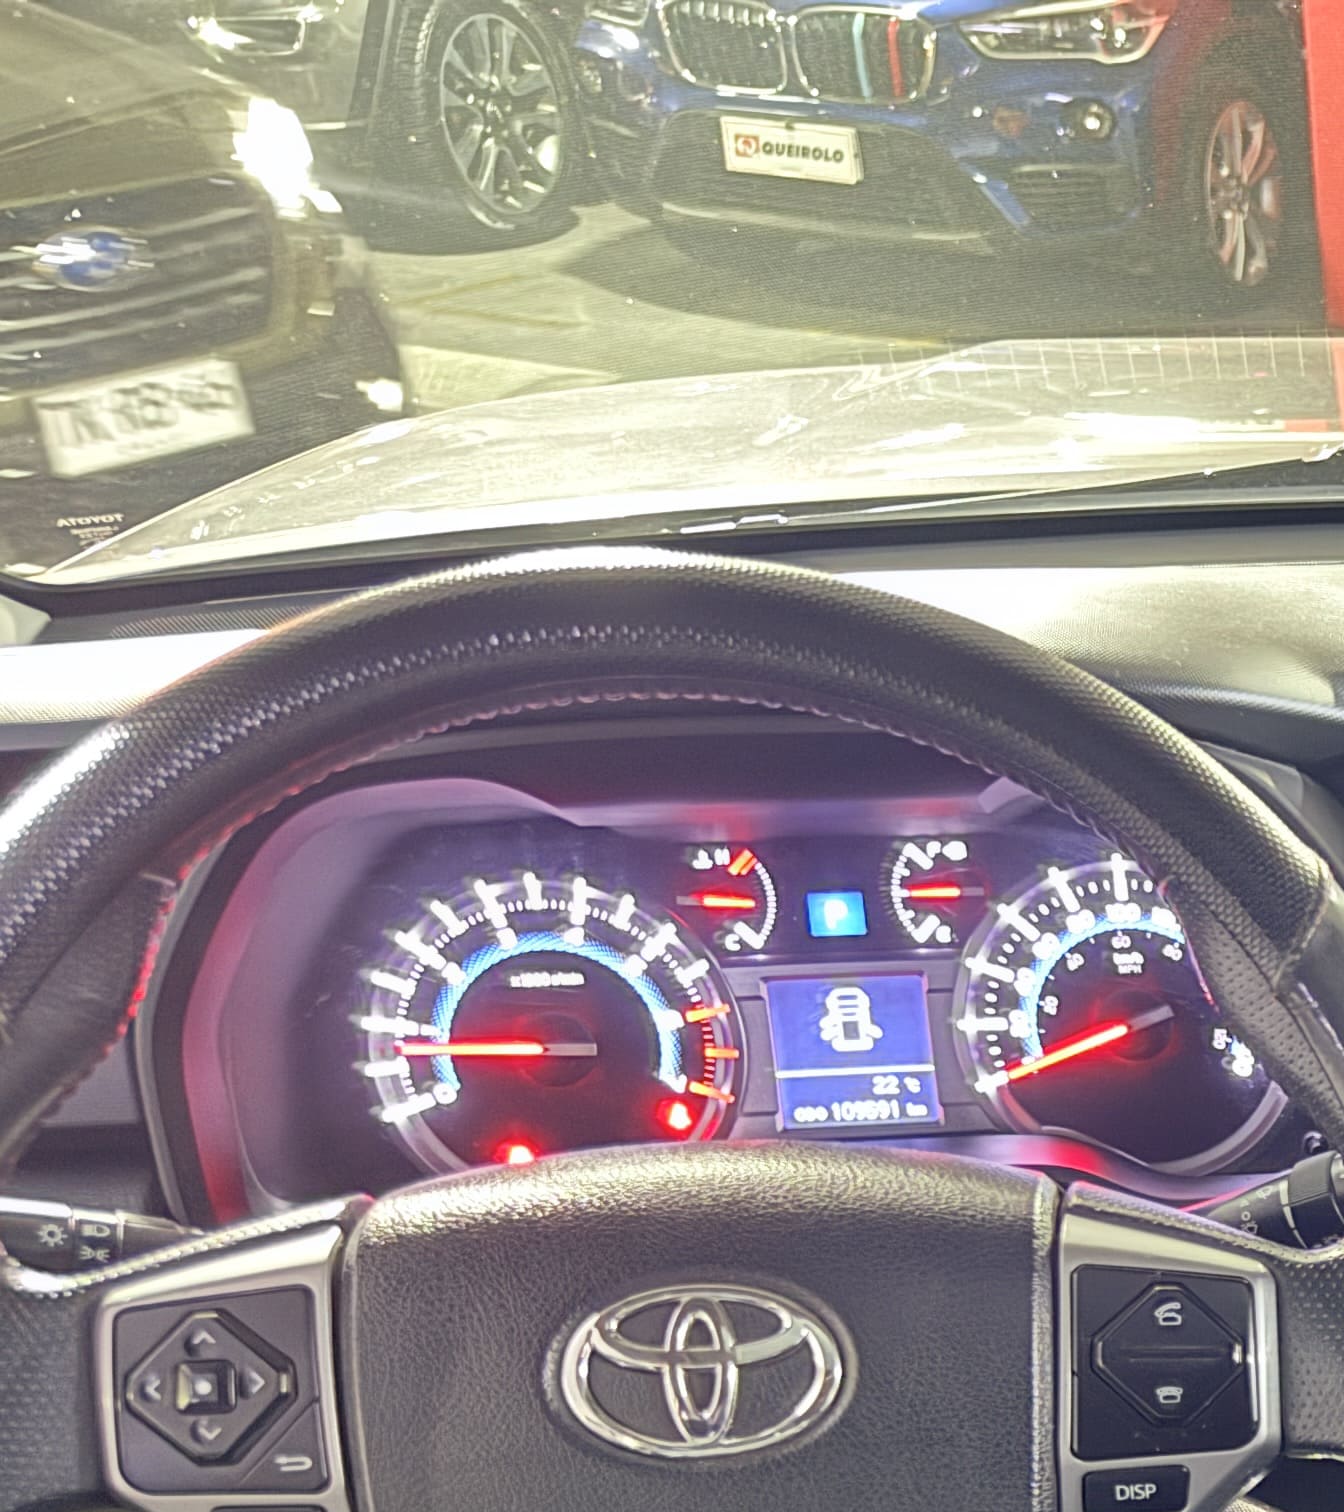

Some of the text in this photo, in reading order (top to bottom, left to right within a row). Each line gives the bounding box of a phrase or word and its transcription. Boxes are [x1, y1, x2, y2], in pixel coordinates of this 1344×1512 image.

[761, 141, 845, 163] QUEIROLO
[822, 899, 849, 930] P
[871, 1074, 900, 1095] 22
[1115, 1483, 1157, 1501] DISP
